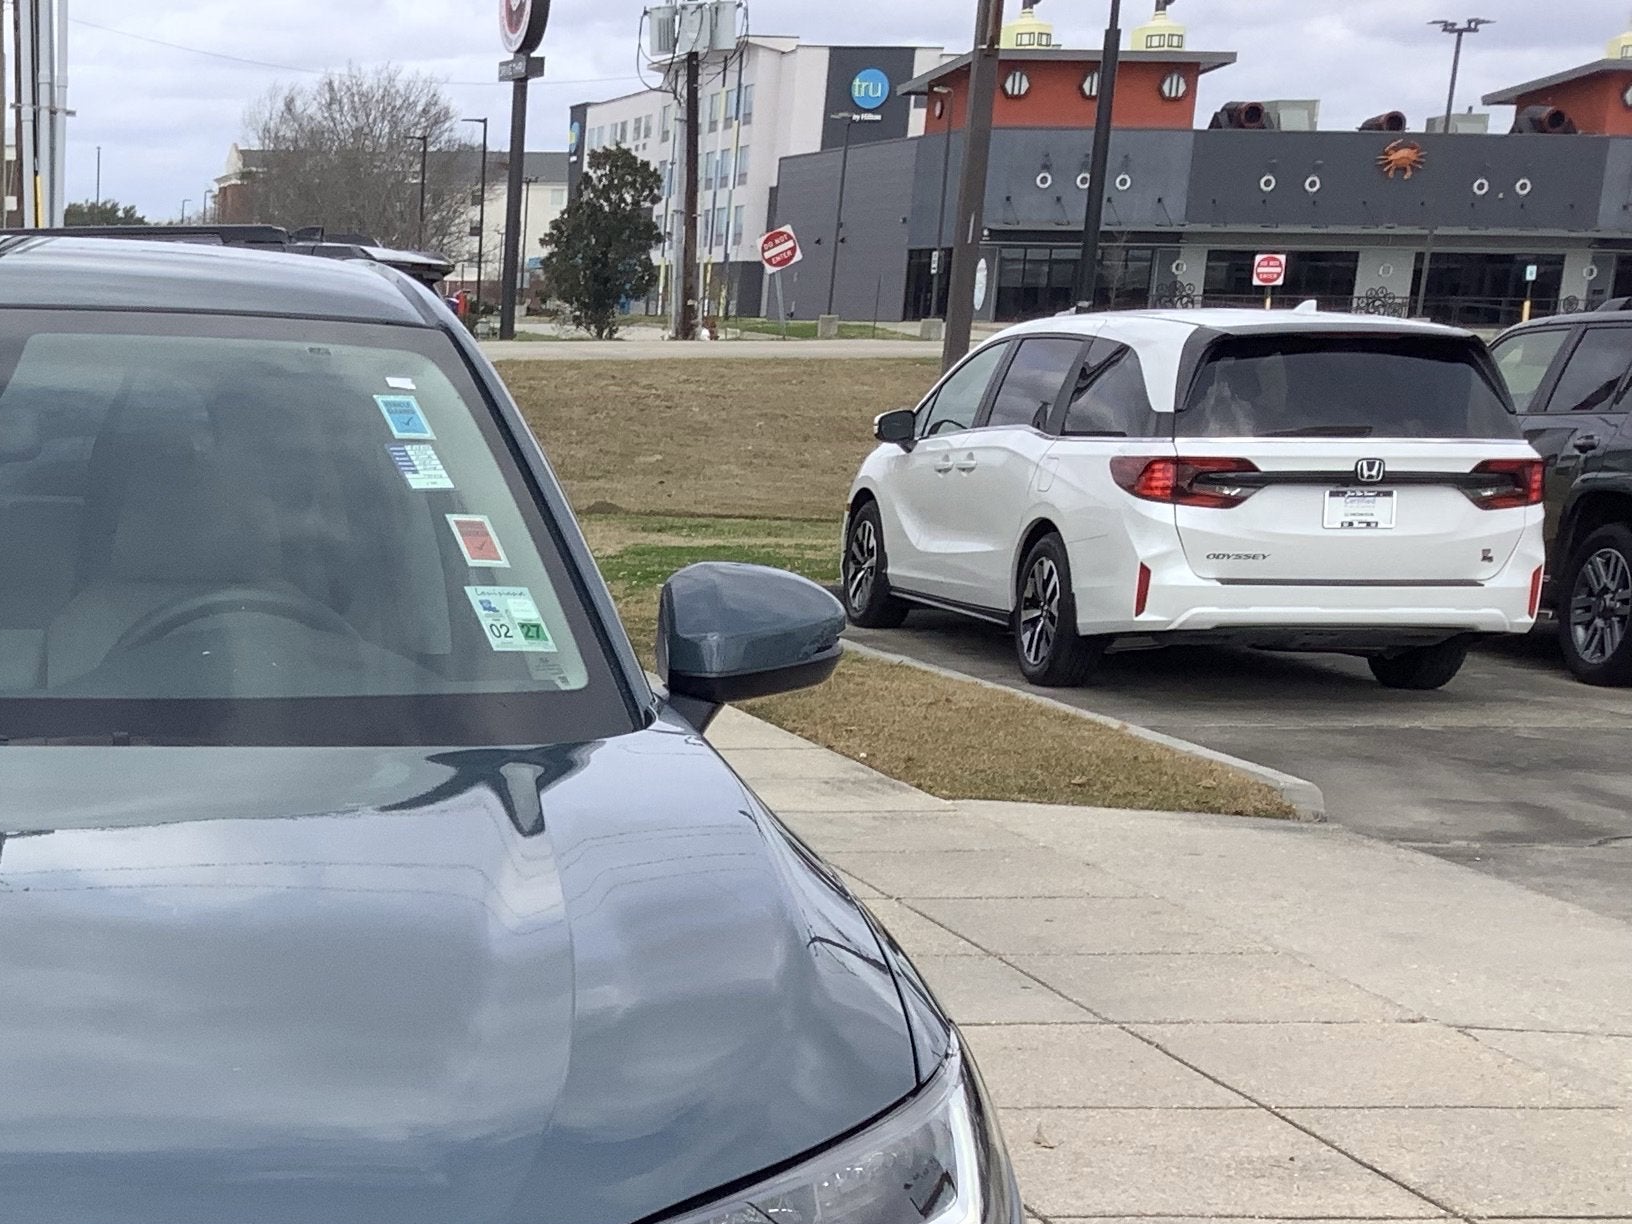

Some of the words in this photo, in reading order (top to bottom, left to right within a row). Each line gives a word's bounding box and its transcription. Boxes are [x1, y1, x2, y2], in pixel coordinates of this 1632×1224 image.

[853, 78, 882, 98] tru
[775, 234, 788, 244] NOT
[771, 250, 792, 264] ENTER
[489, 623, 513, 638] 02
[521, 623, 541, 639] 27
